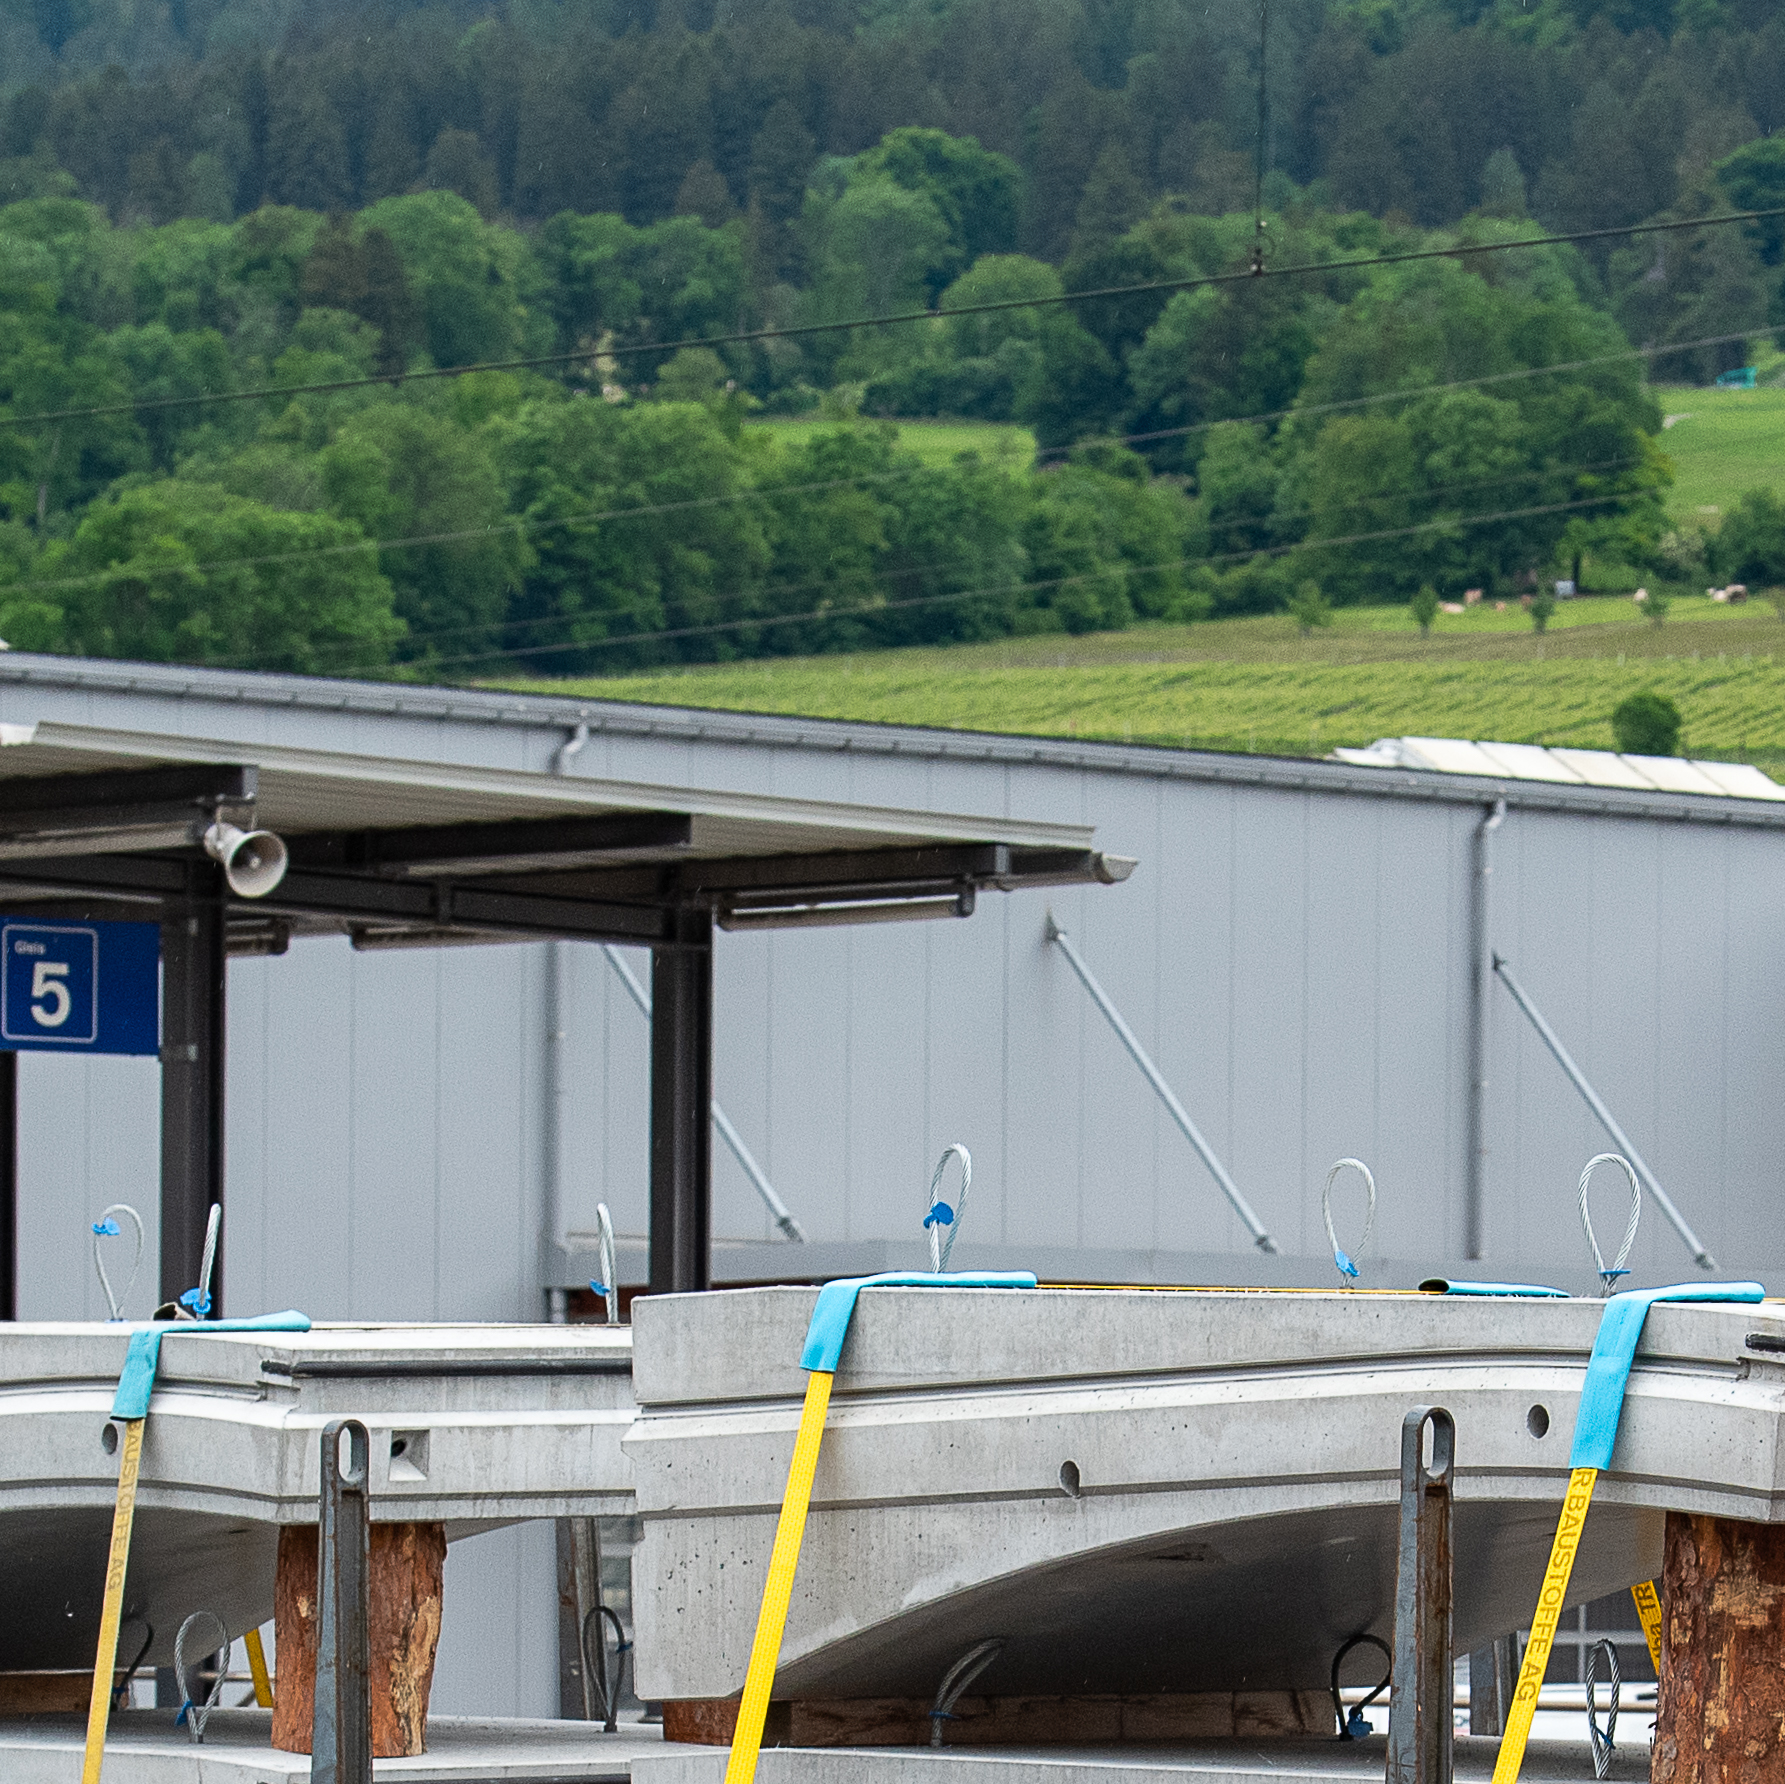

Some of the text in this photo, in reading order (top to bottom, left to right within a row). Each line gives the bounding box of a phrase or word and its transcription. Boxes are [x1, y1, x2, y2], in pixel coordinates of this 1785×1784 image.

[31, 962, 71, 1027] 5
[1528, 1494, 1588, 1655] BAUSTOFFE
[1517, 1661, 1542, 1702] AG
